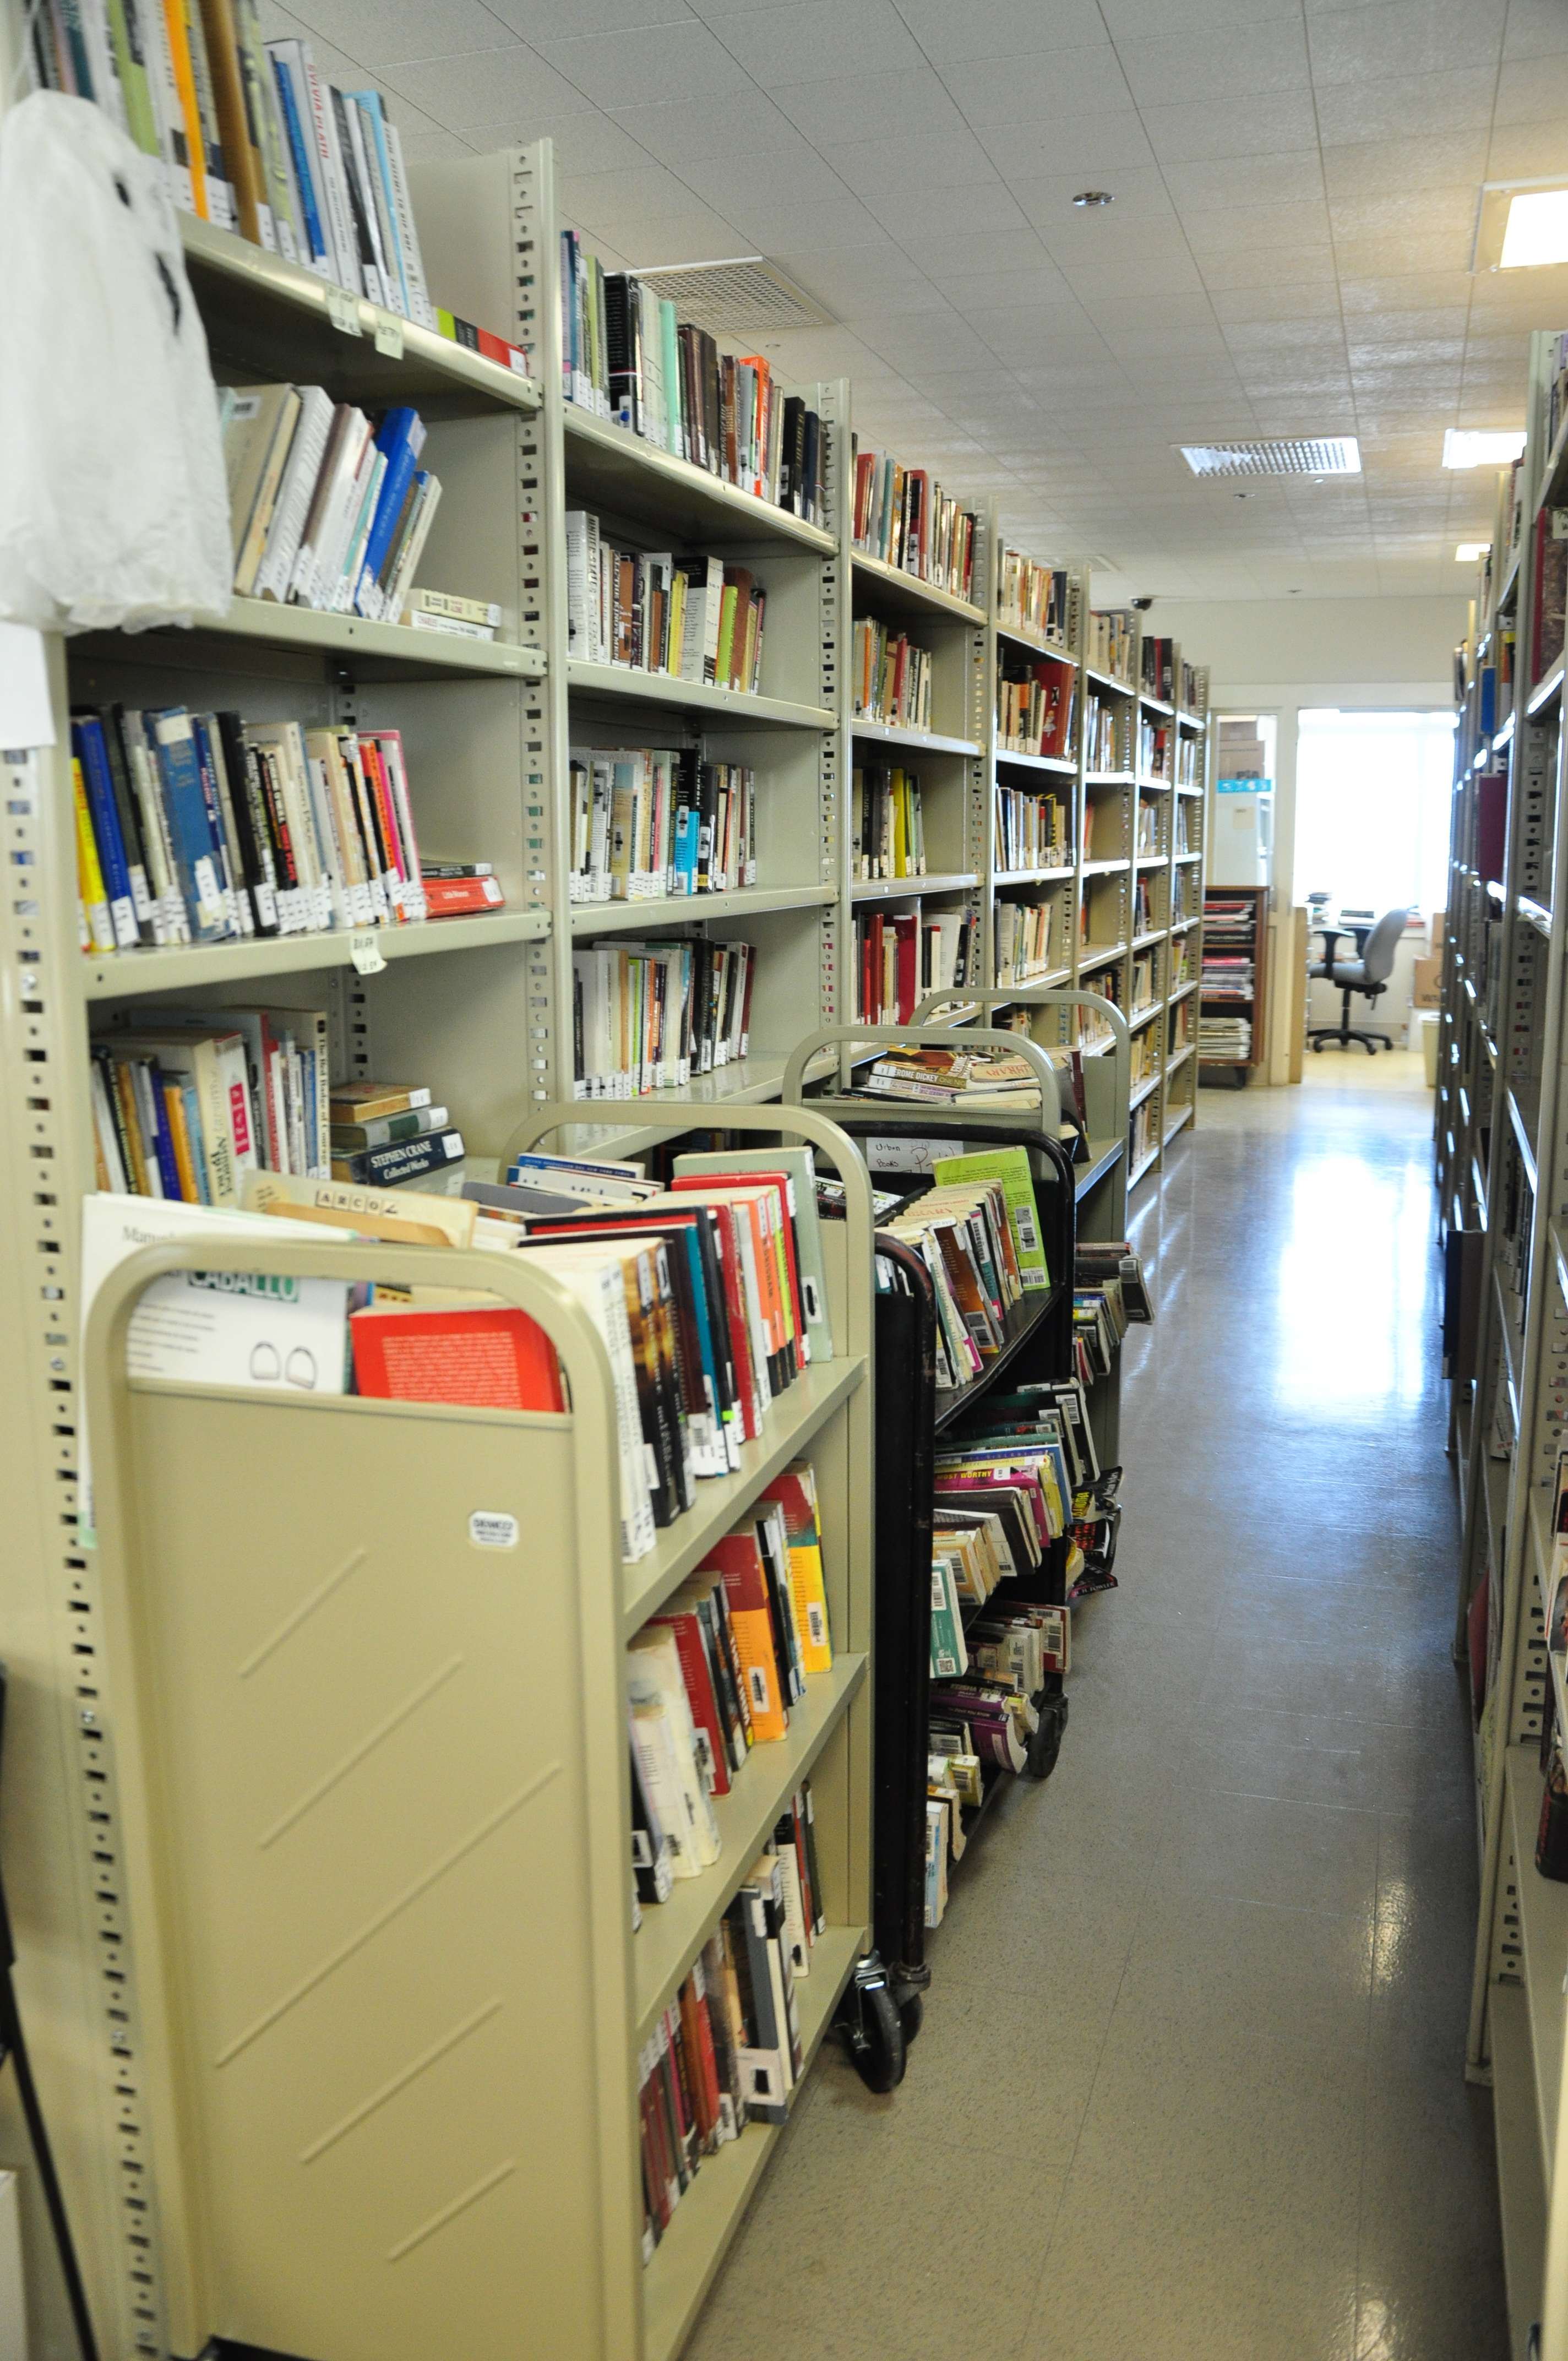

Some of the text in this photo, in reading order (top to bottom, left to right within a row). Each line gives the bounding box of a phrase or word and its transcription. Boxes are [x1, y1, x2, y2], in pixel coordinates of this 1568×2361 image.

[308, 64, 330, 159] SYLVIA PLATH
[895, 1068, 915, 1080] EROME
[916, 1071, 939, 1082] DICKEY
[371, 1140, 433, 1168] STEPHEN CRANE
[876, 1143, 901, 1152] Urban
[383, 1158, 430, 1180] Collected Works
[876, 1158, 900, 1168] Books
[320, 1194, 379, 1210] ARCO
[189, 1269, 295, 1299] CABALLO
[960, 1470, 993, 1479] WORTHY
